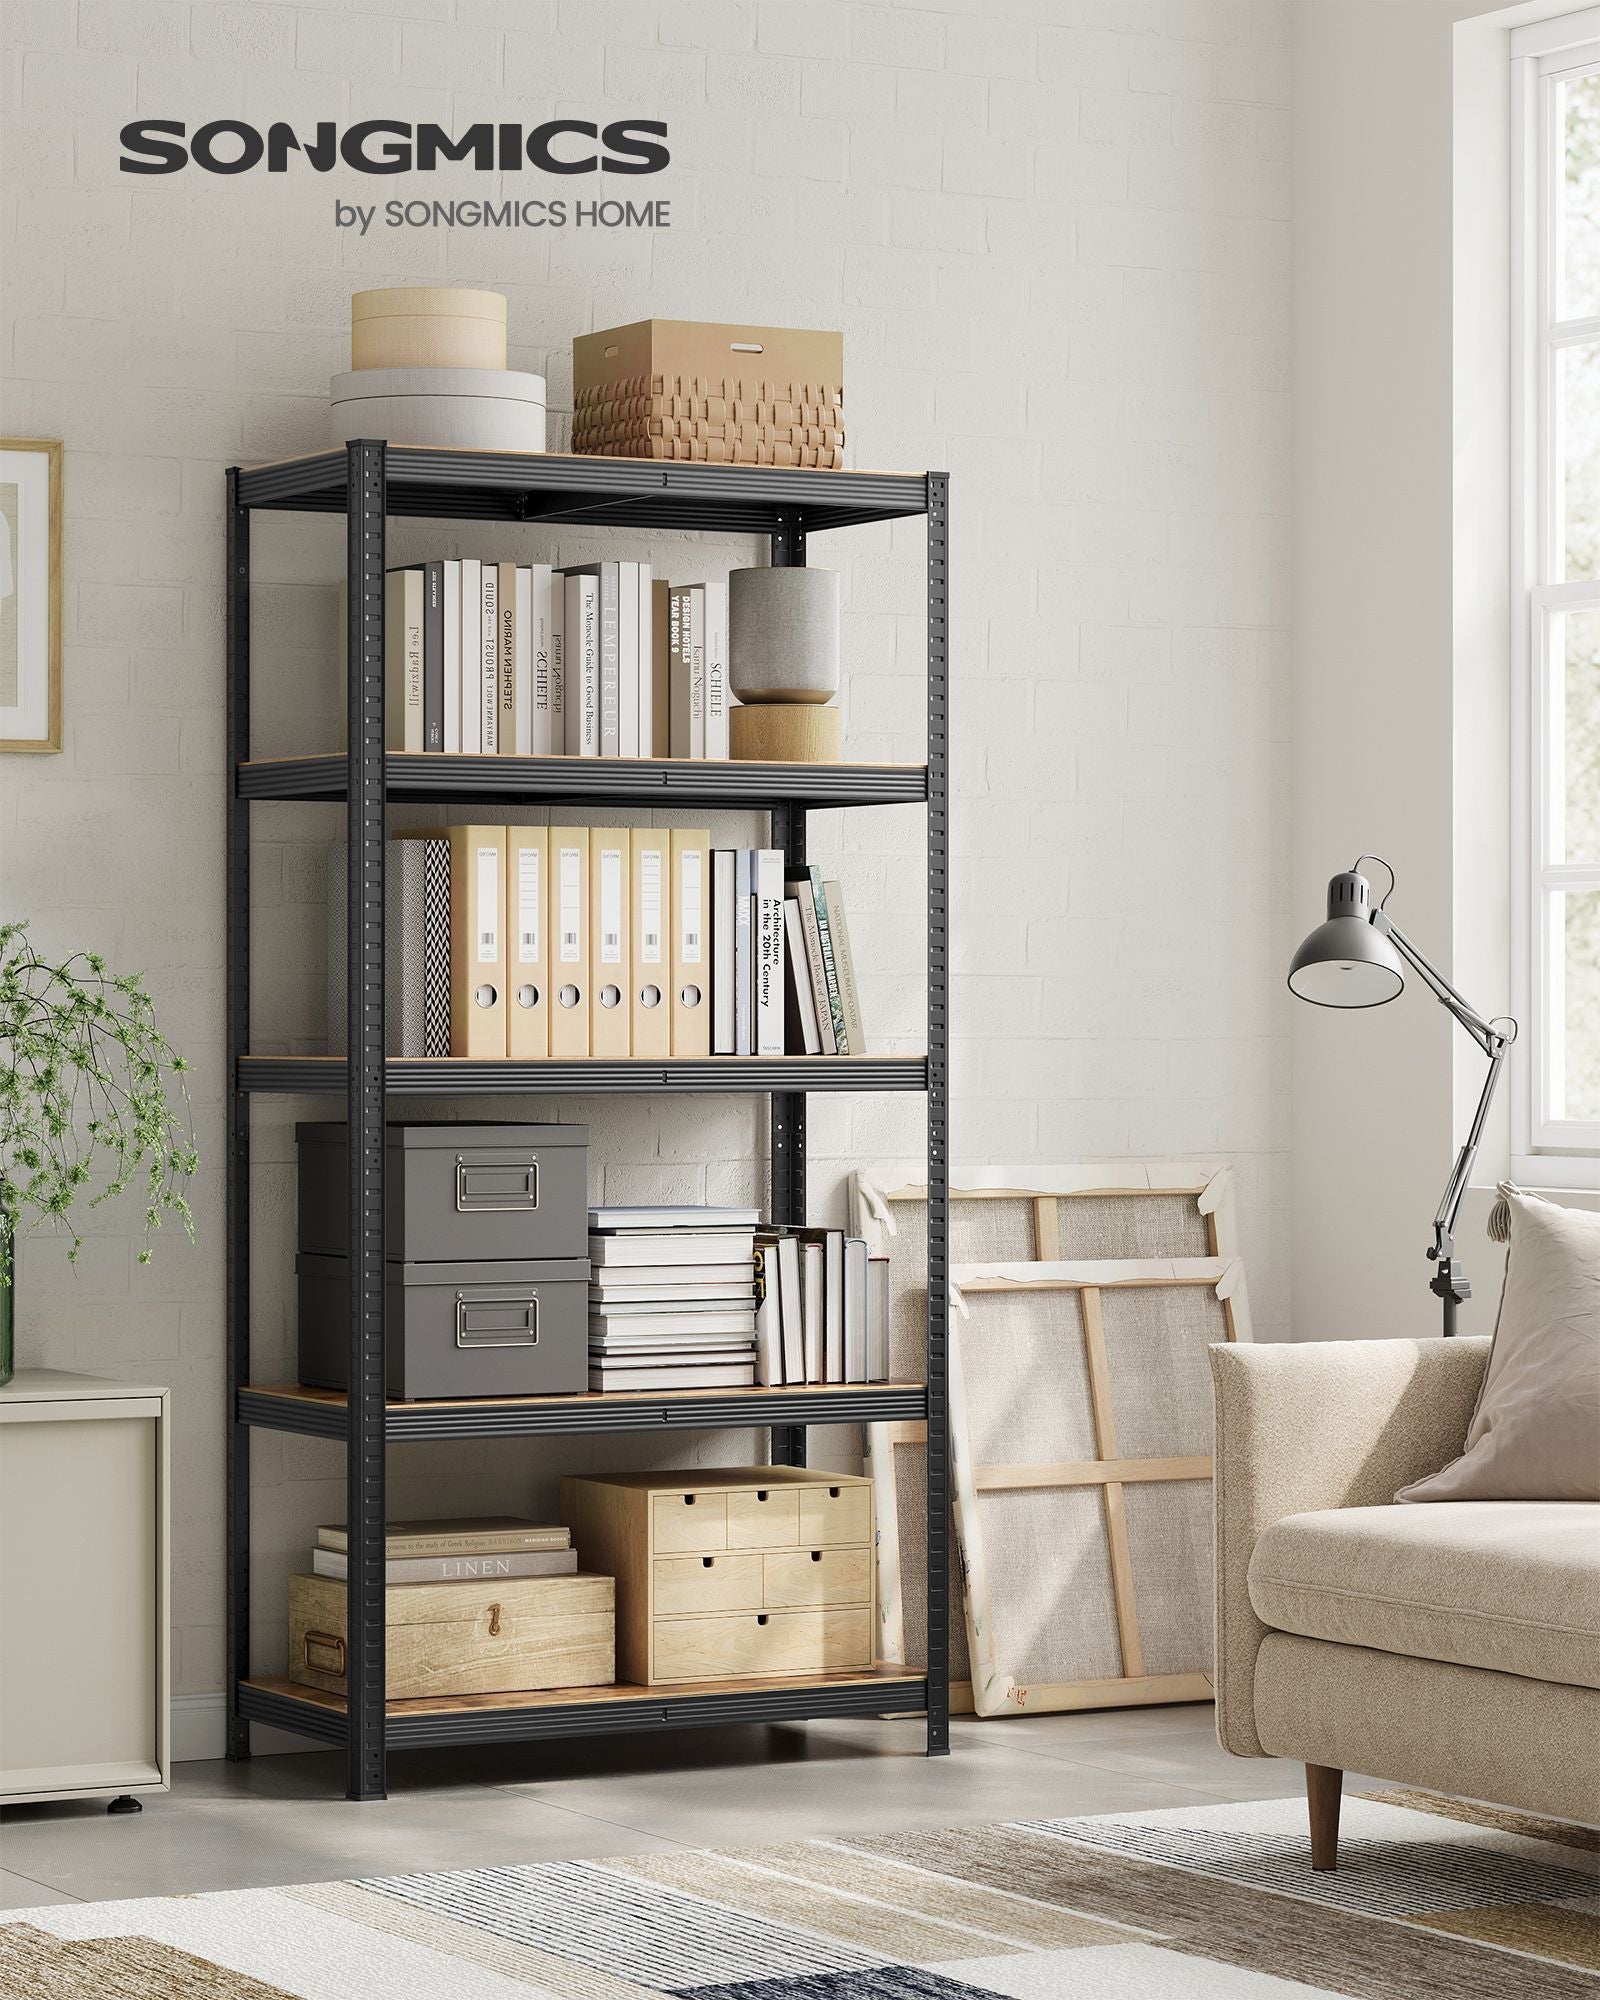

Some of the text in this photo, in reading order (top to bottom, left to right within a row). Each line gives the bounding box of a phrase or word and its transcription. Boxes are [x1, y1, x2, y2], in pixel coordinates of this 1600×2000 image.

[671, 595, 680, 618] YEAR
[671, 620, 680, 645] BOOK
[682, 596, 691, 664] DESIGN HOTELS
[585, 593, 594, 745] The Monocle Guide to Good Business
[604, 607, 616, 737] LEMPEREUR
[692, 645, 702, 719] Isamu Noguchi
[710, 662, 722, 717] SCHIELE
[738, 895, 750, 926] MMXX
[772, 899, 782, 965] Architecture
[760, 899, 772, 1007] in the 20th Century
[808, 925, 818, 962] Monocle
[818, 920, 838, 997] AN AUSTRALIAN GARDEN
[813, 964, 822, 986] Book
[833, 906, 857, 1030] NATIONAL MUSEUM OF QATAR
[817, 988, 824, 997] of
[818, 998, 830, 1031] JAPAN
[425, 1541, 439, 1551] study
[443, 1559, 511, 1577] LINEN
